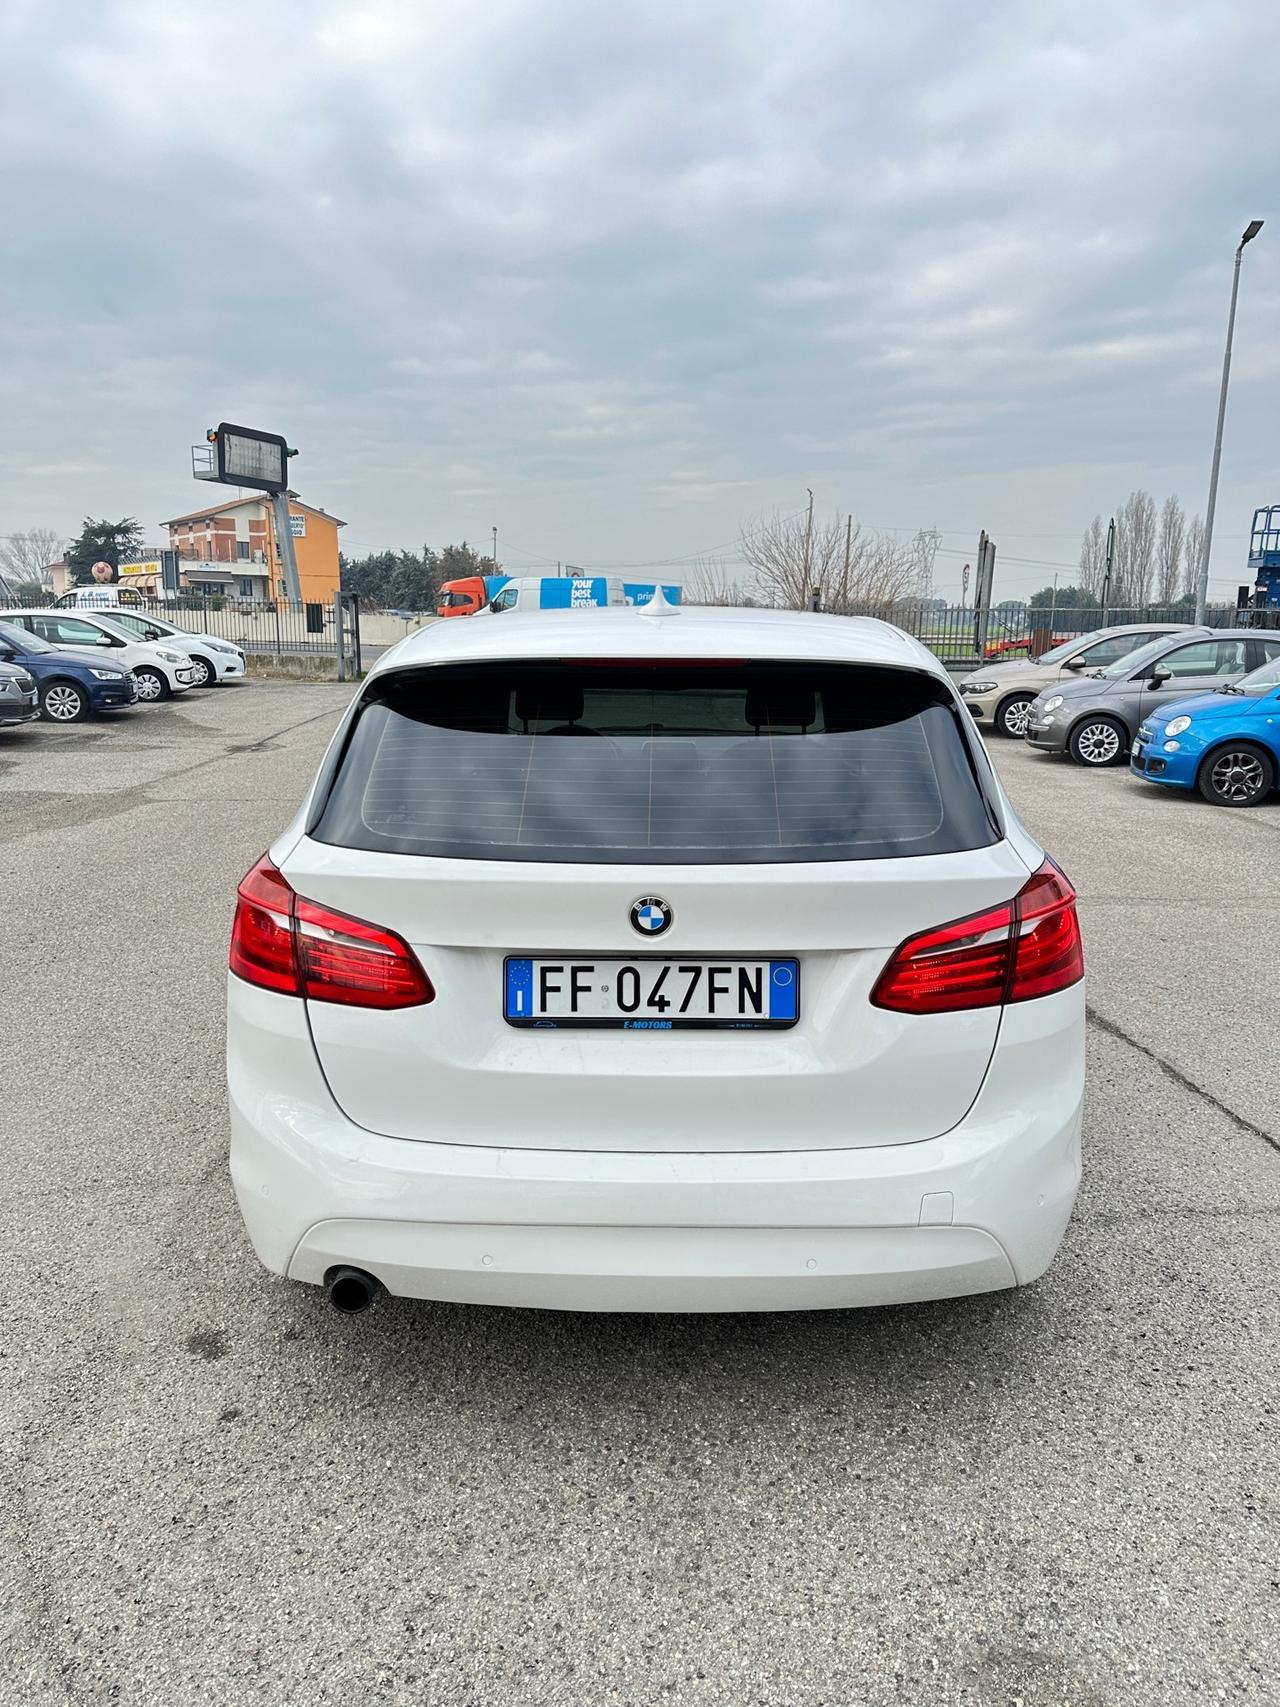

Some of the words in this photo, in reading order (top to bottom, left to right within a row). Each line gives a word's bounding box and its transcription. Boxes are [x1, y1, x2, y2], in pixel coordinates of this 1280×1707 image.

[572, 579, 594, 589] your
[571, 589, 591, 598] best
[571, 598, 598, 608] break
[633, 898, 669, 912] BMW
[540, 966, 594, 1012] FF
[617, 966, 762, 1013] 047FN
[623, 1020, 673, 1030] E-MOTORS
